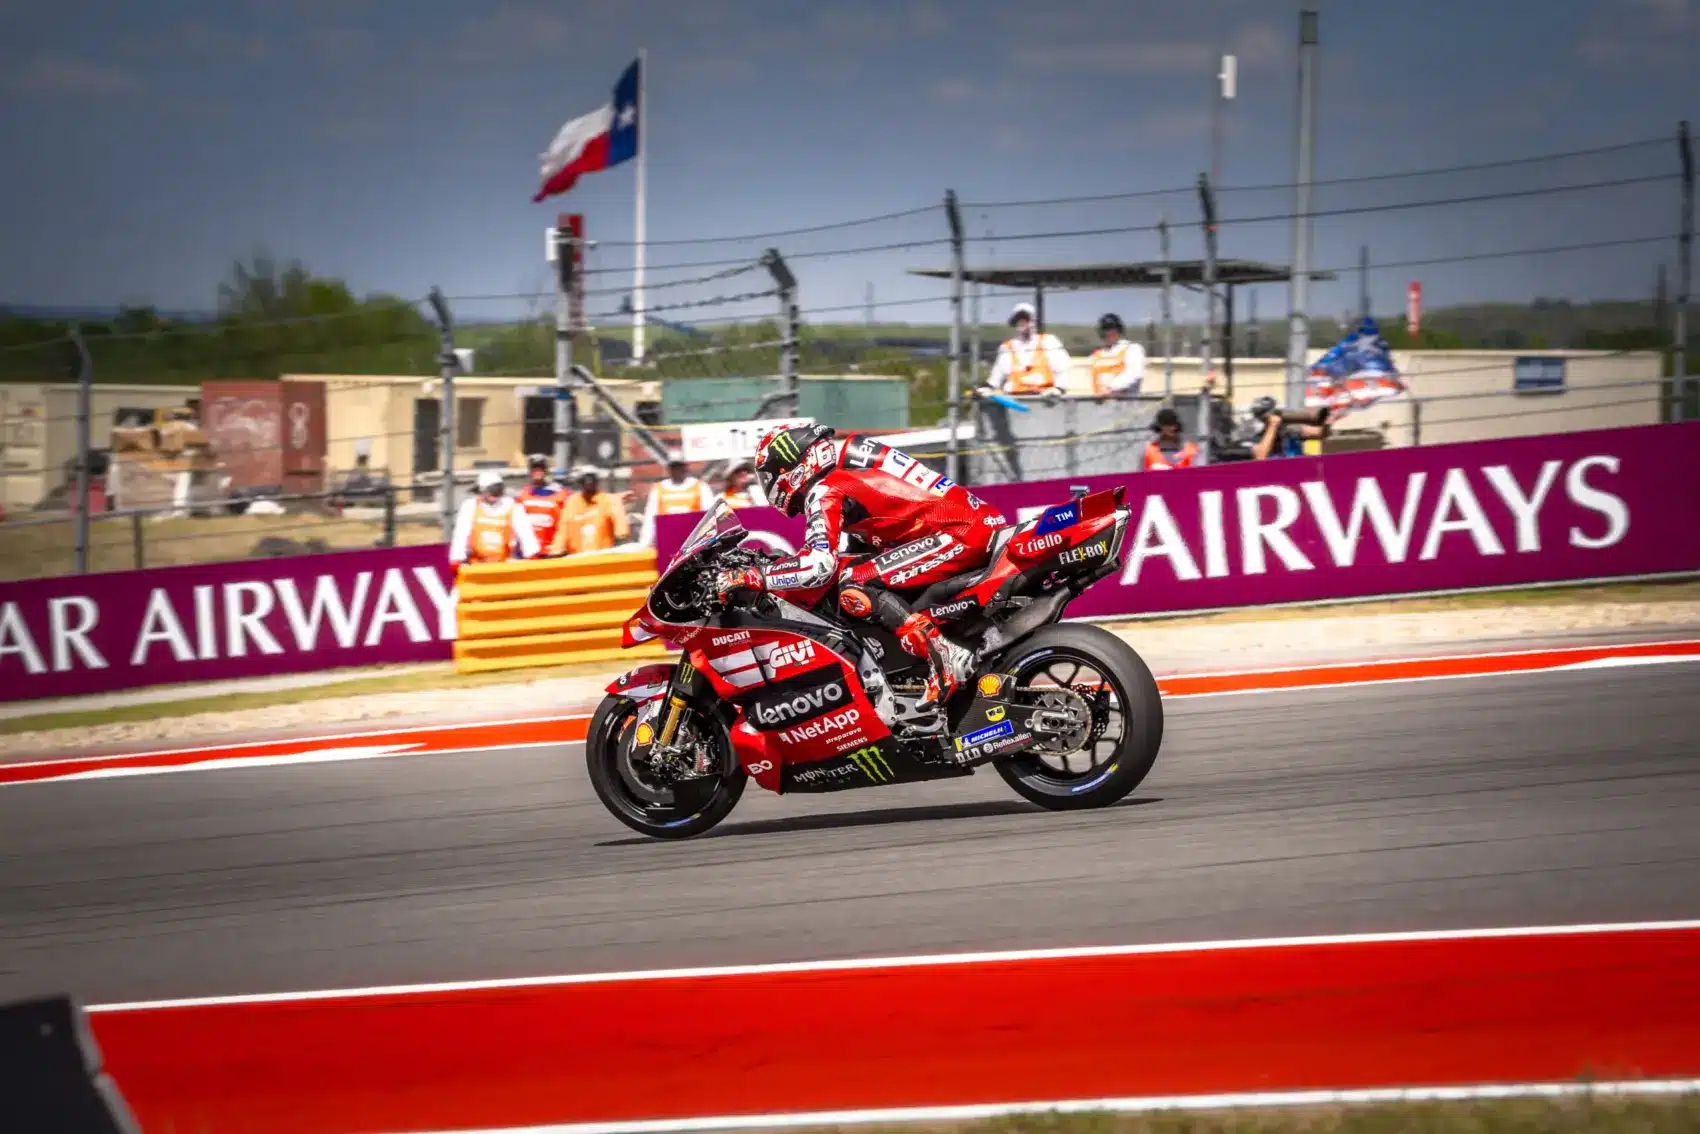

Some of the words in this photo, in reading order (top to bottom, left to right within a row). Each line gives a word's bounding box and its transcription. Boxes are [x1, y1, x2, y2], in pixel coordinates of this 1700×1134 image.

[1055, 510, 1074, 522] TIM
[1120, 455, 1630, 586] AIRWAYS
[880, 536, 934, 565] Lenovo
[1027, 534, 1063, 553] riello
[1058, 541, 1108, 565] FLEX-BOX
[889, 542, 965, 585] alpinestars
[771, 573, 799, 587] Unipol
[930, 600, 969, 618] Lenovo
[711, 630, 751, 647] DUCATI
[769, 639, 816, 669] GIVI
[793, 707, 861, 743] NetApp
[836, 736, 868, 752] SIEMENS
